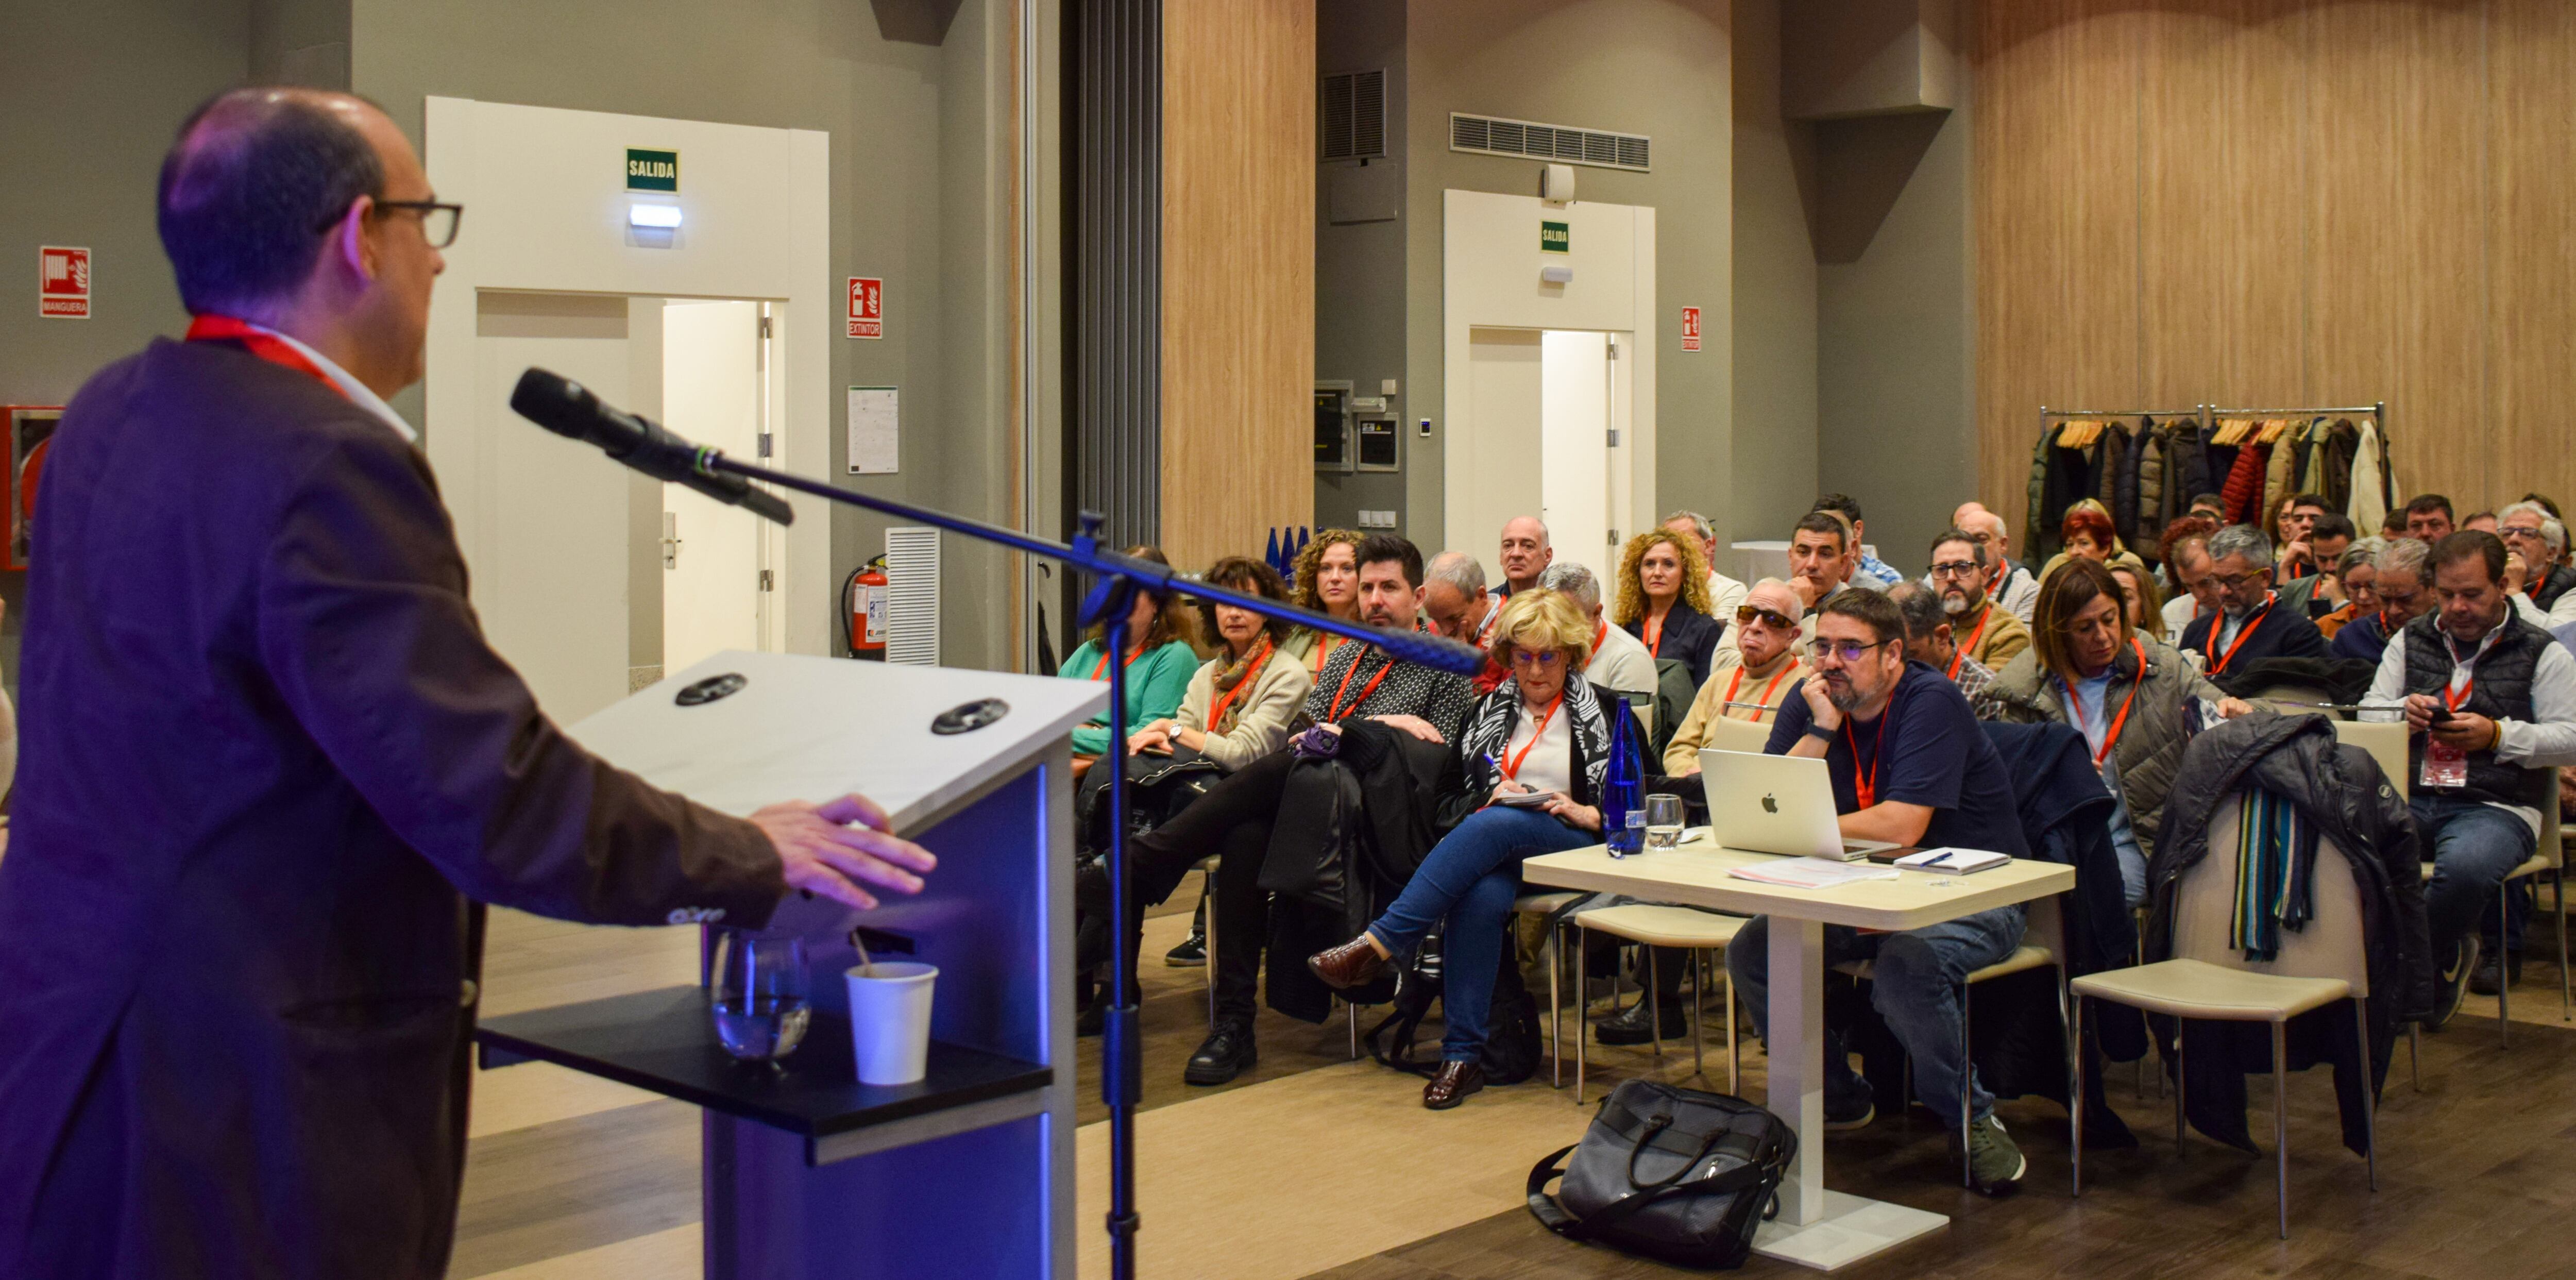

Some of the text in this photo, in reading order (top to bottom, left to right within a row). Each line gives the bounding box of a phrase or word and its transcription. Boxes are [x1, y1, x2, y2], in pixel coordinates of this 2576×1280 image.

[630, 160, 674, 178] SALIDA
[1543, 229, 1567, 242] SALIDA
[43, 301, 87, 312] MANGUERA
[849, 323, 879, 334] EXTINTOR
